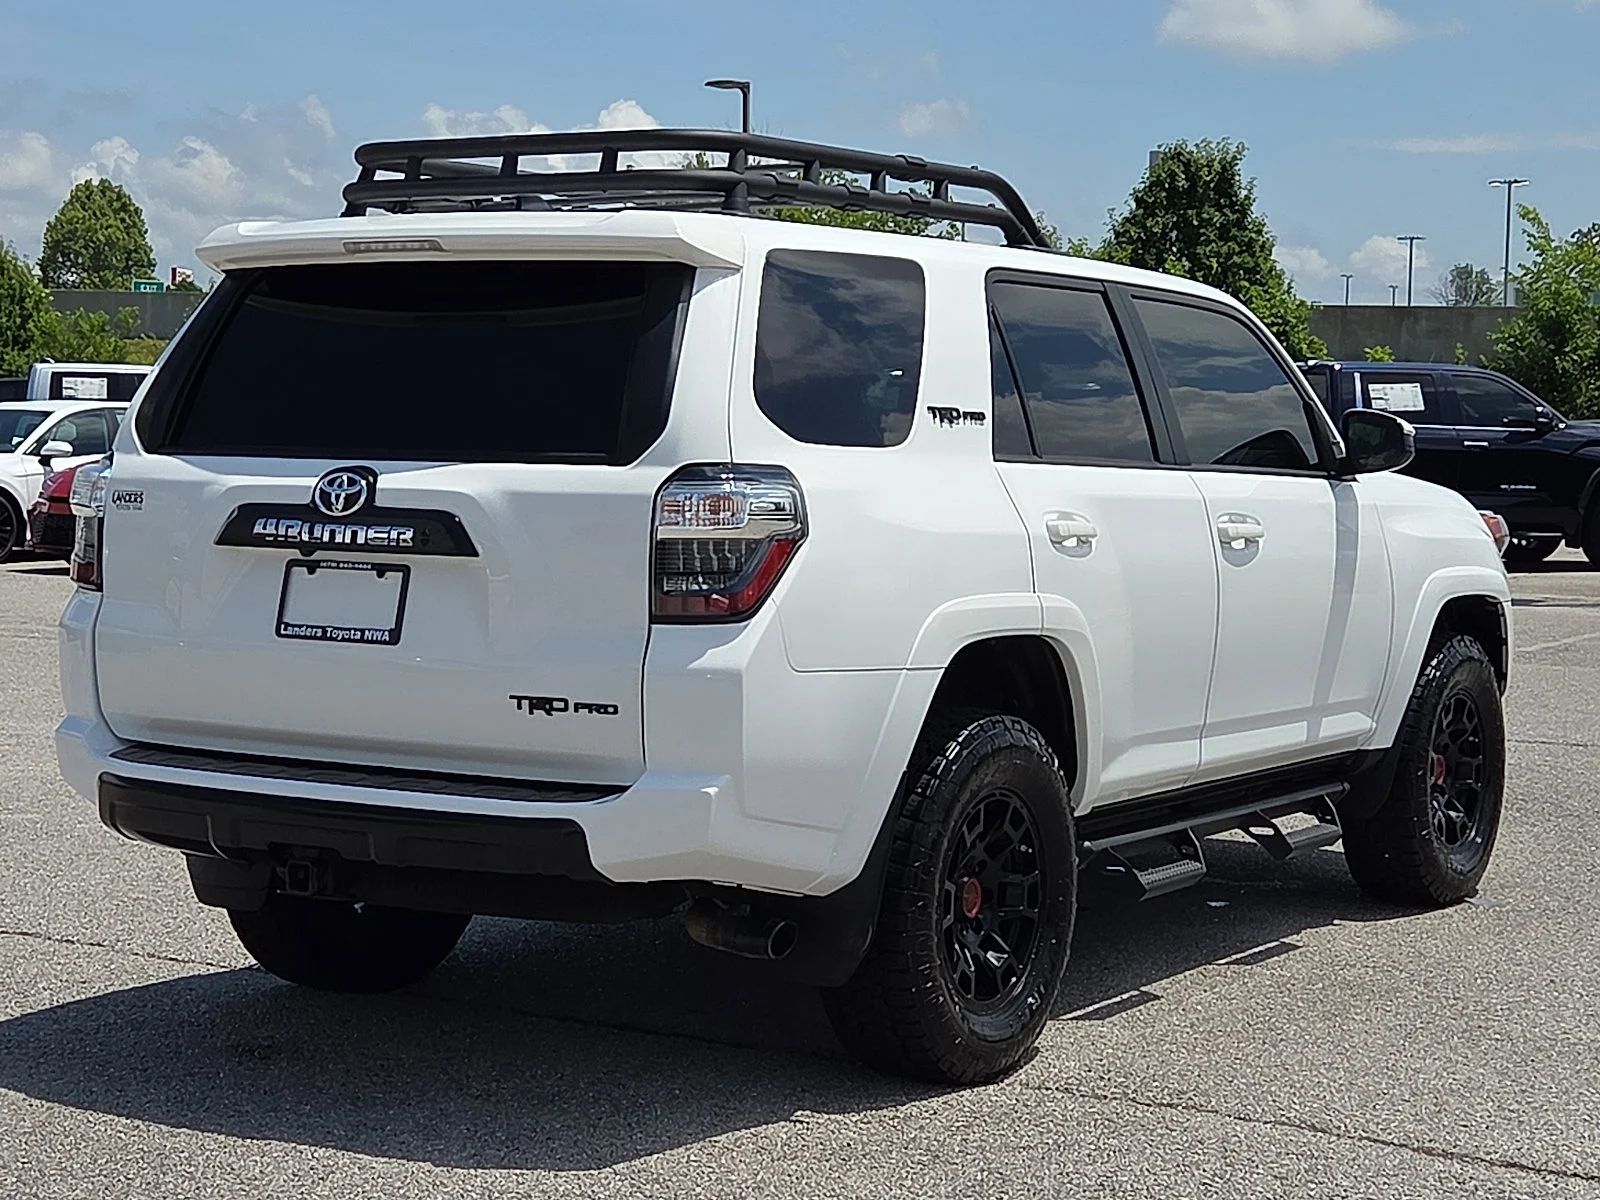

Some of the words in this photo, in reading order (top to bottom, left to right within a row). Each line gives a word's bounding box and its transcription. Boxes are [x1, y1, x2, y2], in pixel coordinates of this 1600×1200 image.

[927, 406, 962, 429] TRD
[253, 518, 414, 547] 4RUNNER
[280, 624, 323, 637] Landers
[325, 627, 361, 641] Toyota
[363, 629, 390, 642] NWA
[509, 695, 569, 717] TRD
[573, 702, 619, 716] PRO
